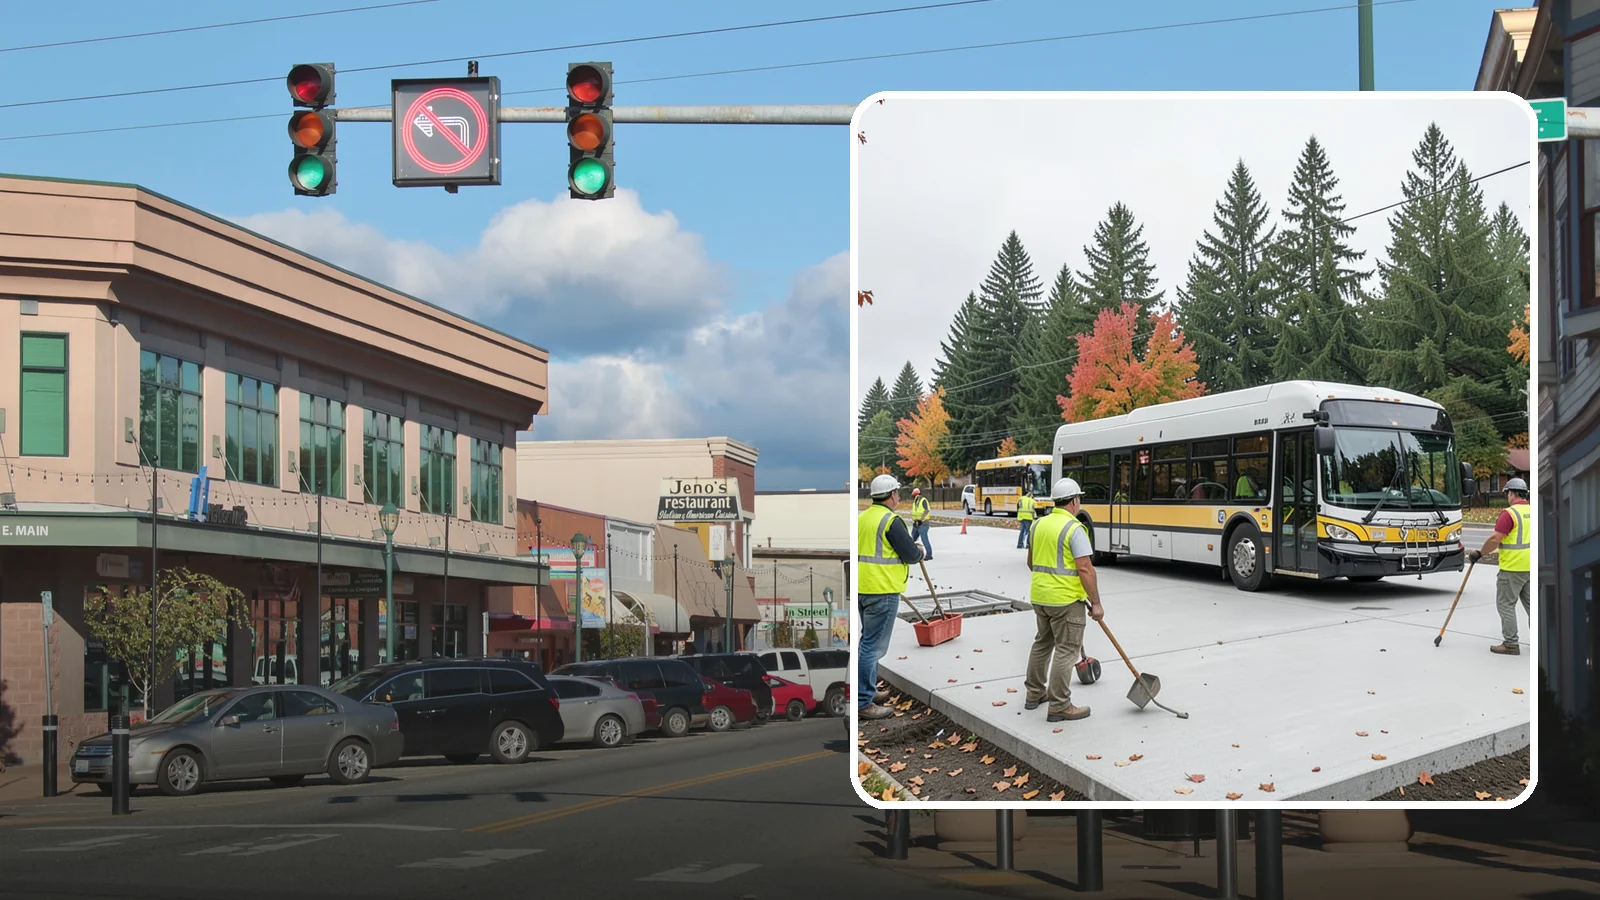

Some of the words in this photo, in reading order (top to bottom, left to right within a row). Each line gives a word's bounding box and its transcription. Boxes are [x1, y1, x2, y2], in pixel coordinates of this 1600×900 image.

[669, 480, 727, 494] Jeno's
[665, 496, 731, 509] restaurant
[658, 510, 681, 519] Italian
[686, 510, 714, 519] American
[715, 509, 738, 519] Cuisine
[2, 525, 13, 536] E.
[15, 525, 49, 536] MAIN
[785, 607, 795, 617] in
[797, 607, 828, 617] Street
[790, 619, 824, 627] lass
